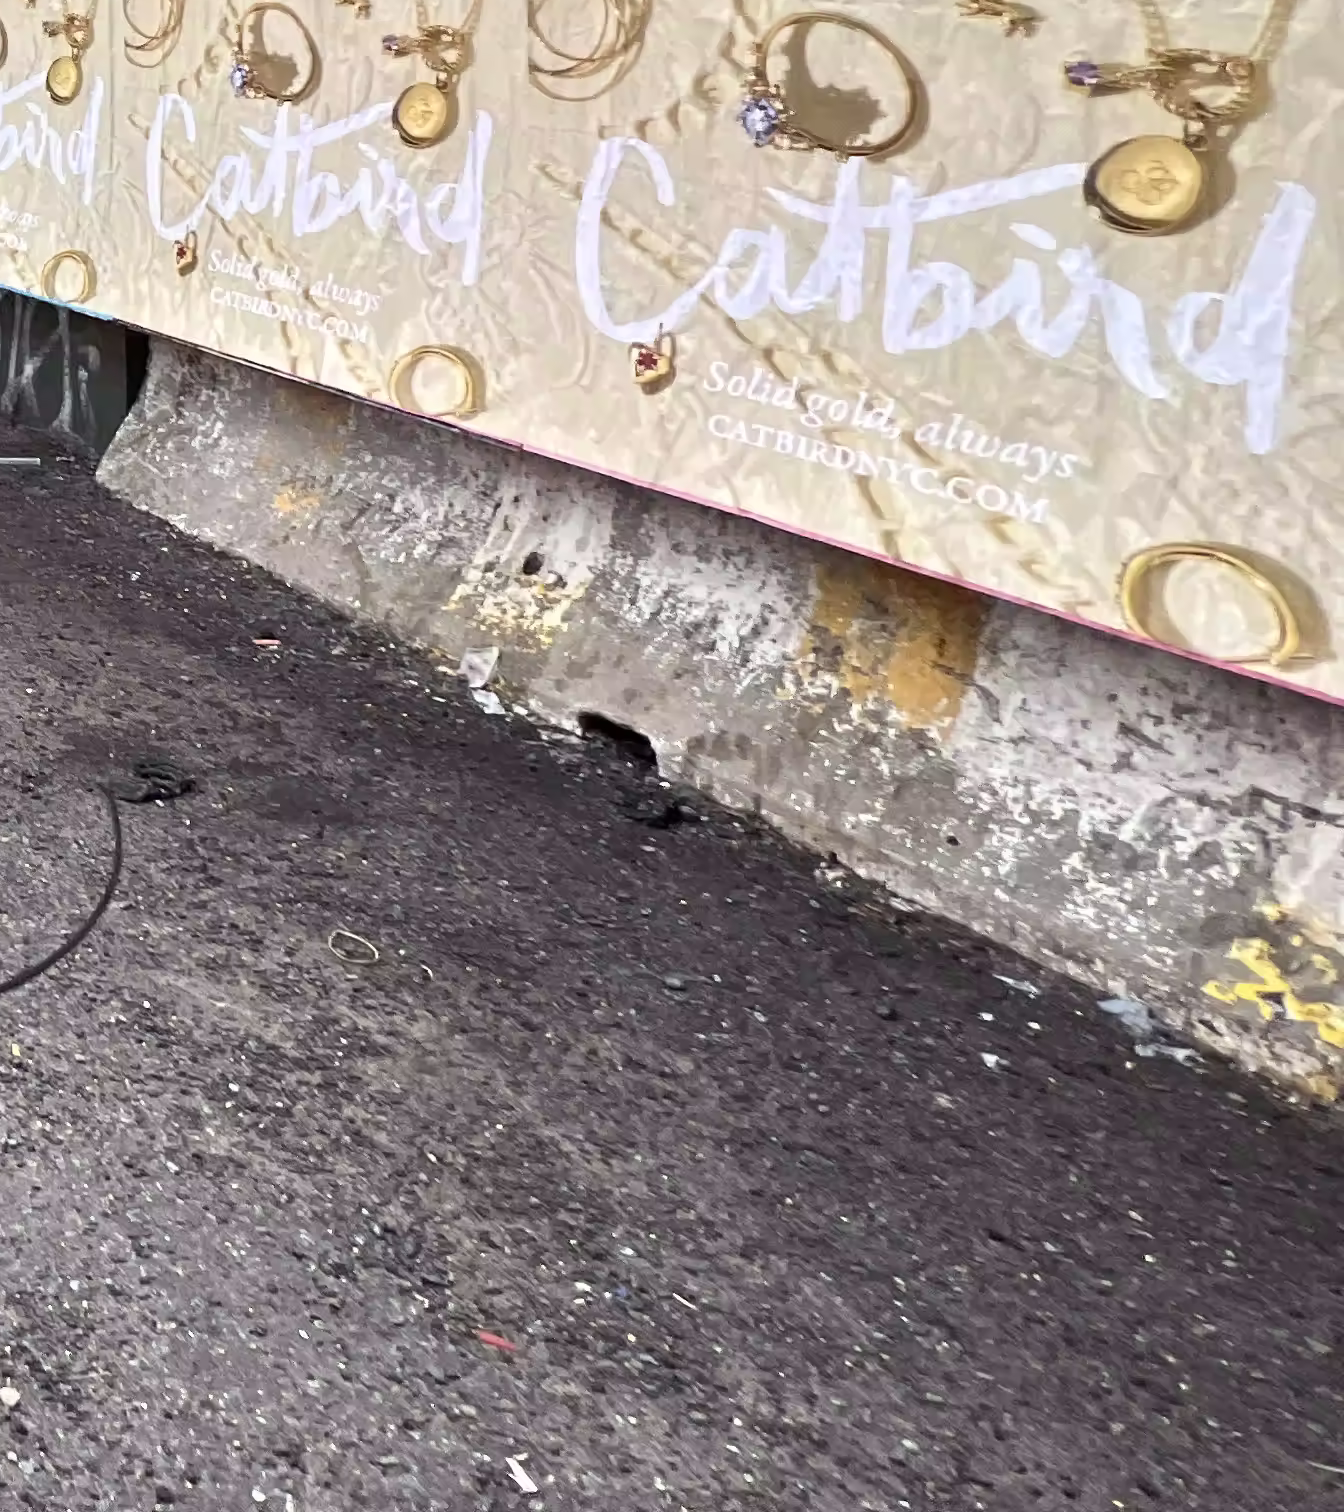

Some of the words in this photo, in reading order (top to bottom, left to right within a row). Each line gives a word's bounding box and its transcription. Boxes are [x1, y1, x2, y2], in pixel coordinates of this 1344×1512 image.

[145, 92, 494, 286] Catbird
[208, 249, 260, 281] Solid
[257, 263, 305, 295] gold,
[309, 272, 381, 316] always
[210, 287, 369, 343] CATBIRDNYC.COM
[574, 135, 1317, 454] Catbird
[702, 361, 801, 410] Solid
[800, 389, 901, 440] gold,
[914, 413, 1080, 484] always
[707, 413, 1050, 525] CATBIRDNYC.COM
